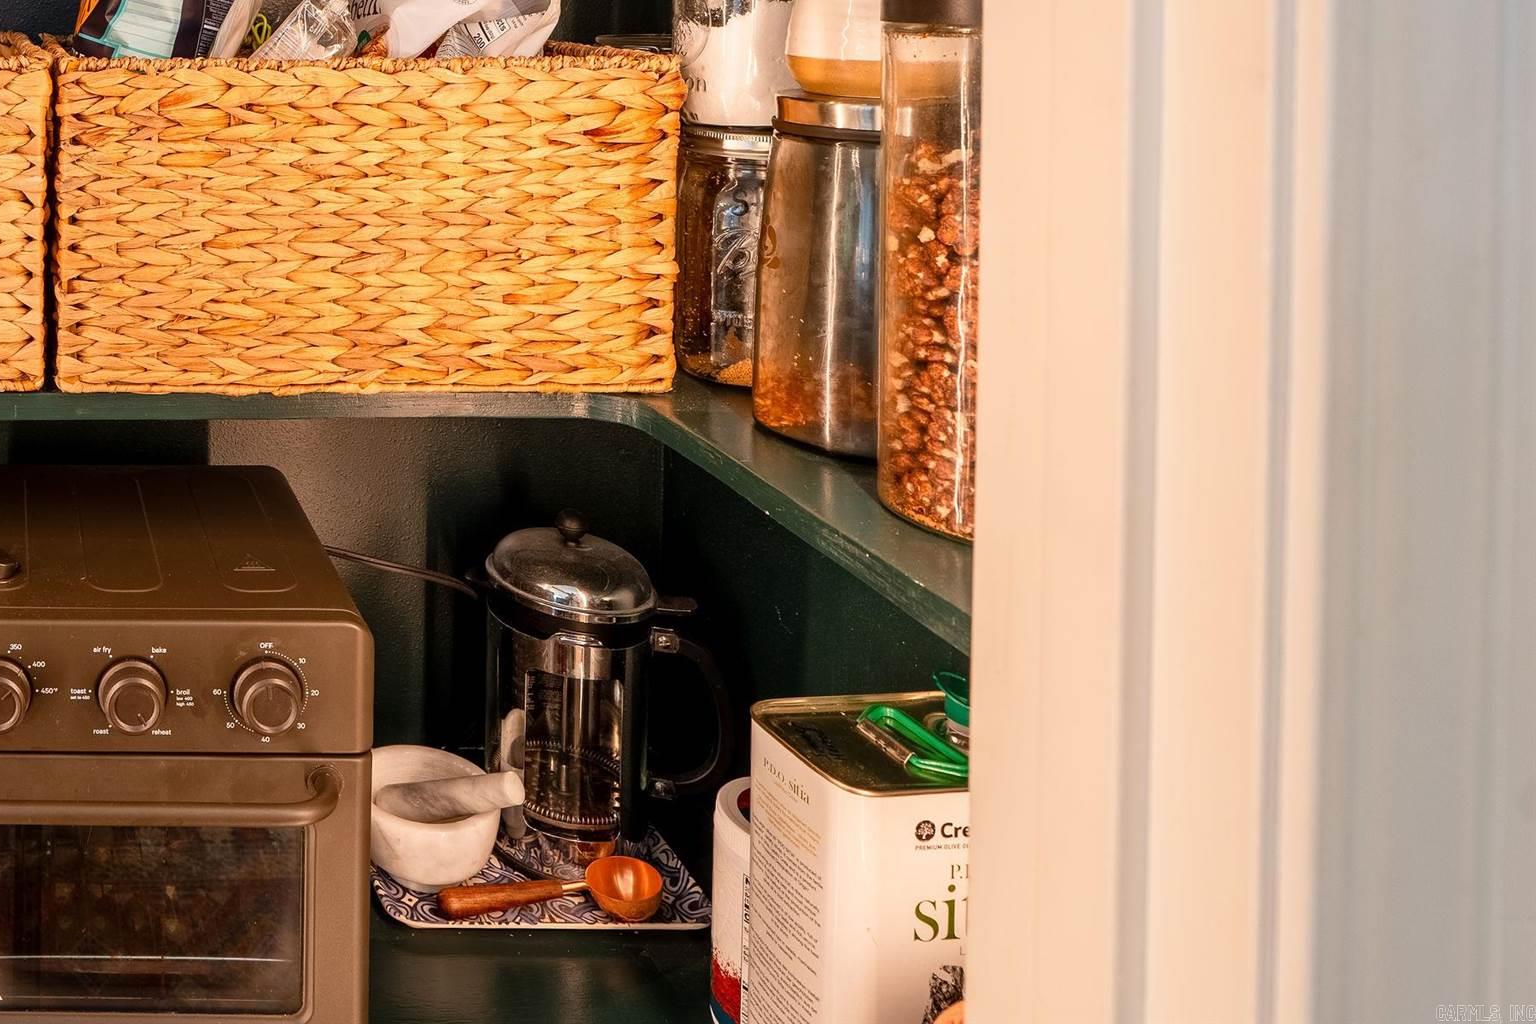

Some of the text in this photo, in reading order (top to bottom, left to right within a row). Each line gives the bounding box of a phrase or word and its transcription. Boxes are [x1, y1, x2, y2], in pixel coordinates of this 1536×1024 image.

[473, 32, 486, 49] 200
[9, 643, 23, 651] 350
[102, 646, 112, 655] fry
[151, 646, 167, 654] bake
[32, 660, 46, 668] 400
[298, 657, 307, 665] 10
[70, 687, 87, 695] toast
[212, 688, 222, 696] 60
[310, 689, 320, 697] 20
[296, 722, 306, 730] 30
[151, 728, 172, 736] reheat
[260, 735, 271, 743] 40
[914, 844, 943, 852] PREMIUM
